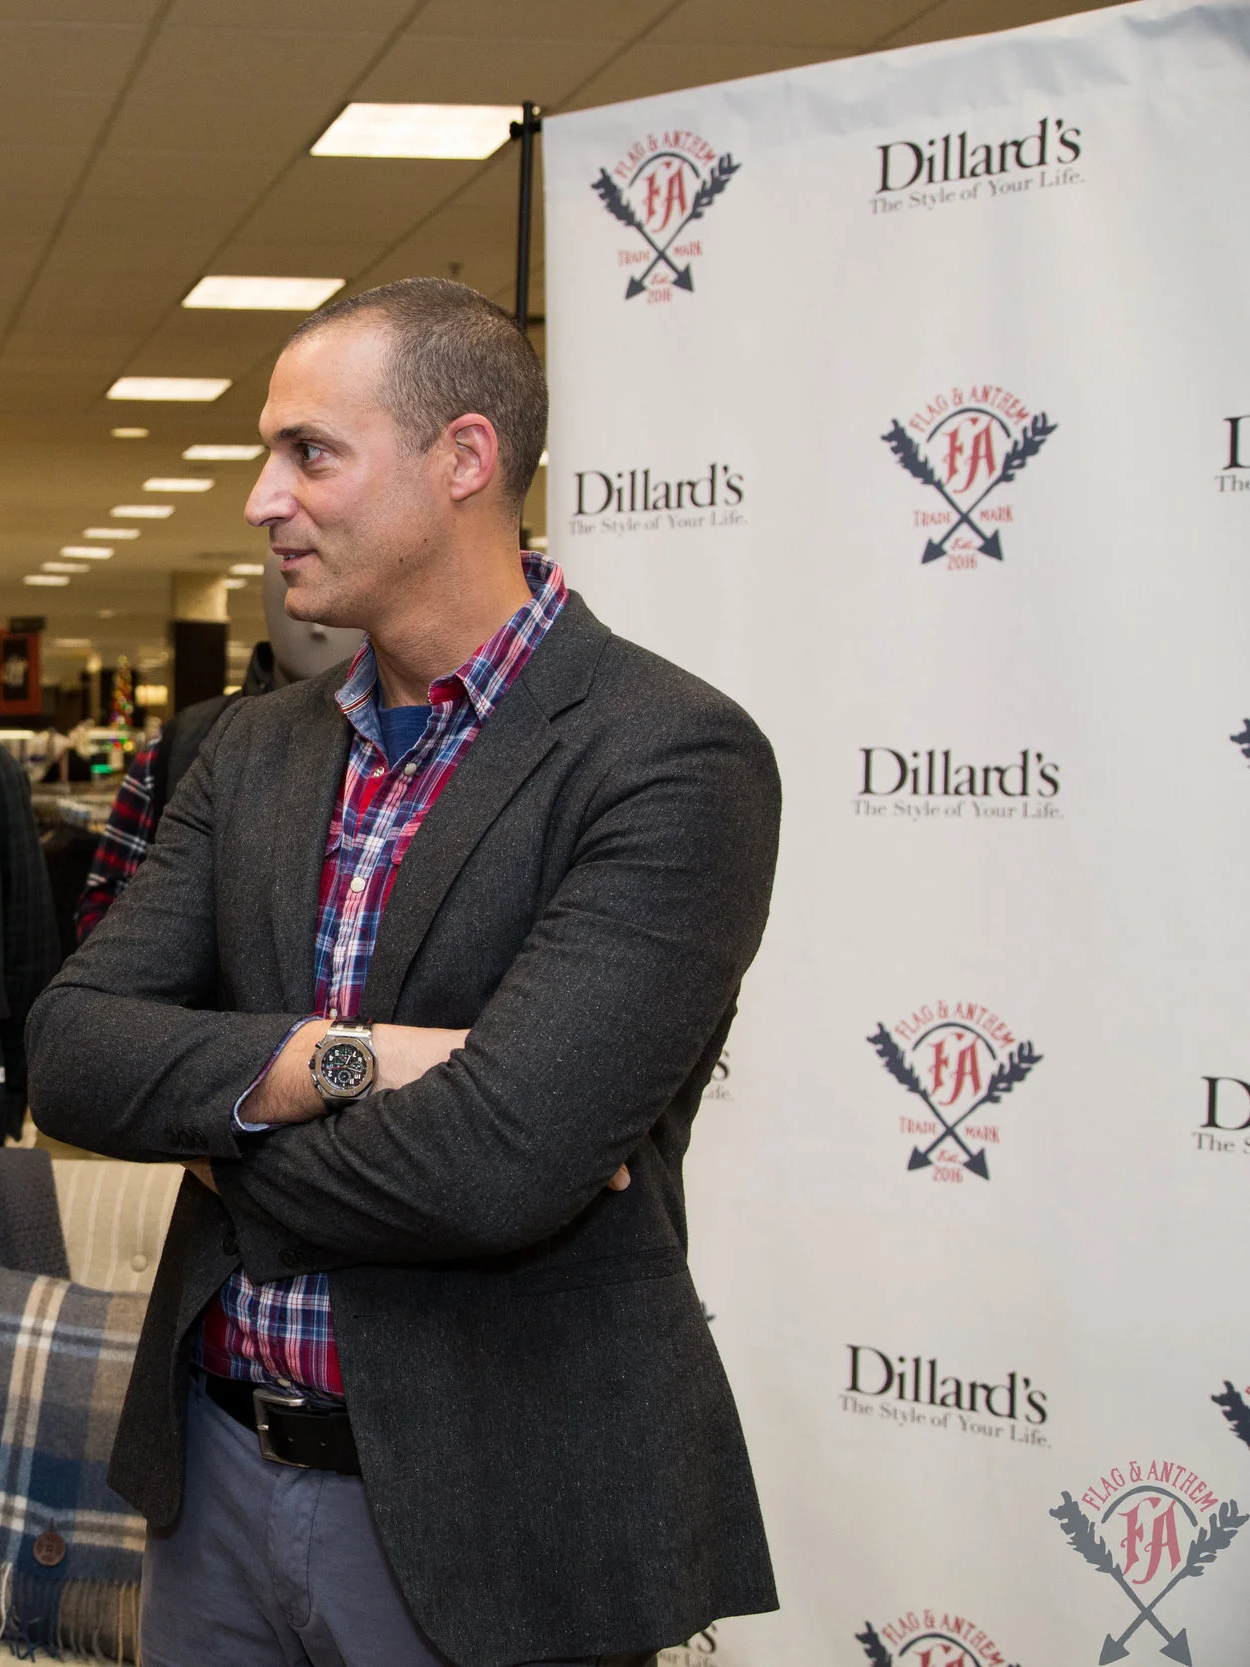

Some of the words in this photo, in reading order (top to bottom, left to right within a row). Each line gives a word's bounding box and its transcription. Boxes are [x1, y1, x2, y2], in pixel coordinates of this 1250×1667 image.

[875, 116, 1082, 194] Dillard's
[869, 197, 902, 215] The
[908, 187, 956, 211] Style
[959, 182, 982, 200] of
[988, 177, 1033, 197] Your
[1039, 167, 1085, 190] Life.
[908, 394, 948, 433] FLAG
[968, 385, 1030, 425] ANTHEM
[573, 461, 744, 516] Dillard's
[568, 520, 596, 536] The
[601, 517, 641, 538] Style
[644, 517, 661, 531] of
[667, 514, 706, 529] Your
[710, 508, 748, 526] Life.
[858, 747, 1060, 798] Dillard's
[852, 800, 887, 817] The
[893, 801, 940, 822] Style
[944, 801, 964, 818] of
[972, 802, 1017, 819] Your
[1022, 802, 1065, 820] Life.
[894, 1005, 934, 1041] FLAG
[955, 1001, 1015, 1049] ANTHEM
[1192, 1132, 1237, 1151] The
[846, 1343, 1048, 1426] Dillard's
[839, 1394, 873, 1415] The
[879, 1402, 927, 1426] Style
[931, 1412, 950, 1429] of
[958, 1415, 1004, 1439] Your
[1010, 1423, 1052, 1449] Life.
[882, 1611, 920, 1645] FLAG
